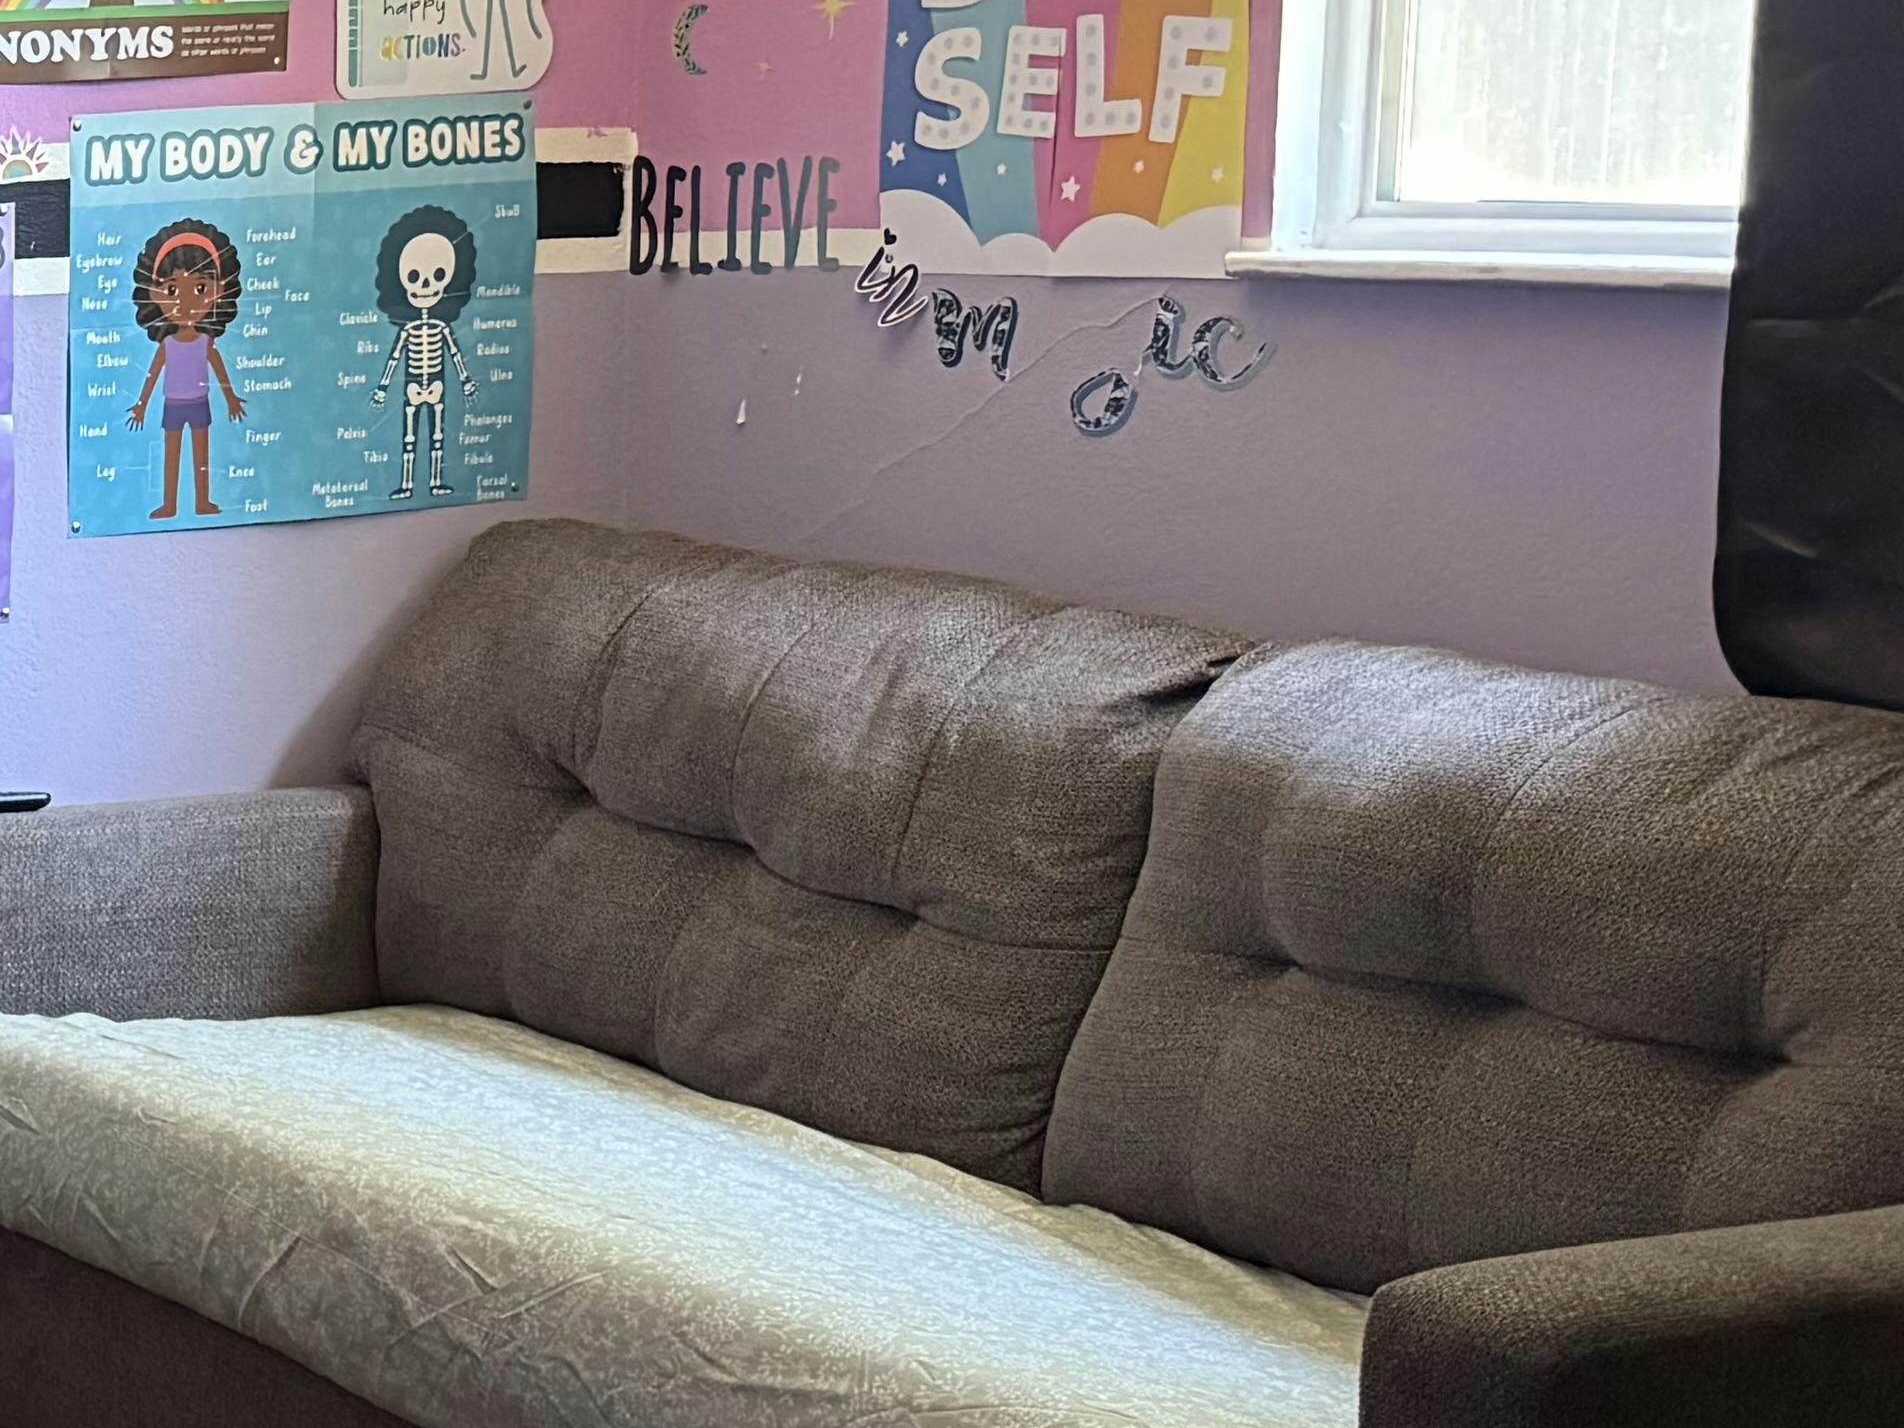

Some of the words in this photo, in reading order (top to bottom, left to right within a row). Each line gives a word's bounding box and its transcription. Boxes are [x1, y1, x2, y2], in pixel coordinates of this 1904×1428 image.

[914, 14, 1233, 150] SELF
[90, 137, 151, 180] MY
[165, 131, 270, 176] BODY
[289, 130, 317, 169] &
[337, 124, 394, 167] MY
[407, 119, 521, 163] BONES
[629, 154, 840, 275] BELIEVE
